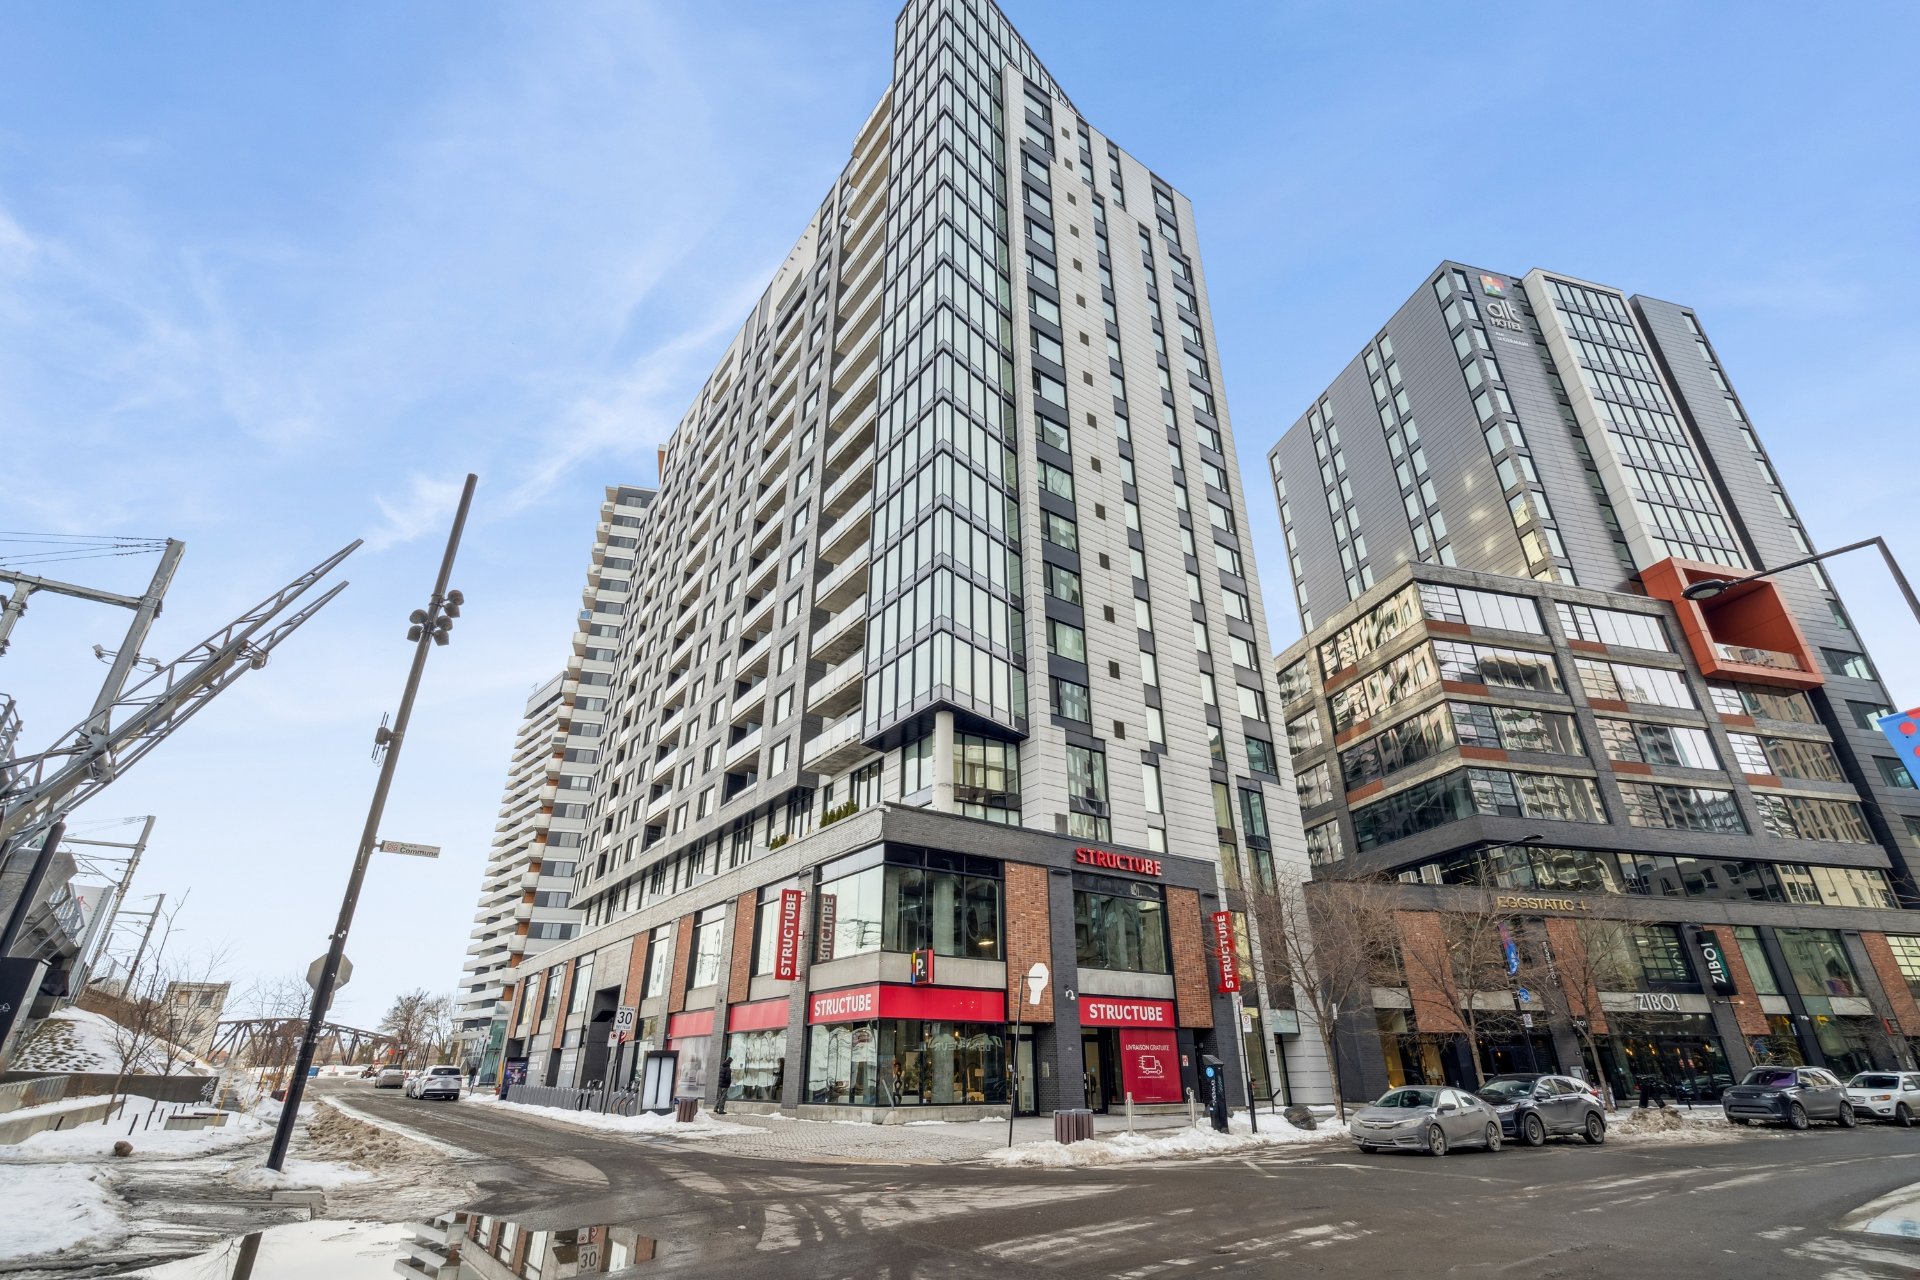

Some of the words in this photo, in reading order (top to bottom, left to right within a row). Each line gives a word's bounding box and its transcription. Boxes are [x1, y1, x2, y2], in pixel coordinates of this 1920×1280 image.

[1487, 300, 1520, 322] alt
[1075, 847, 1162, 876] STRUCTUBE
[1497, 896, 1575, 911] EGGSTATIC
[781, 893, 797, 976] STRUCTUBE
[1217, 914, 1234, 989] STRUCTUBE
[916, 958, 923, 976] P
[1700, 942, 1726, 984] ZIBO!
[814, 993, 872, 1017] STRUCTUBE
[1089, 1003, 1163, 1022] STRUCTUBE
[1636, 993, 1681, 1011] ZIBO!
[617, 1011, 633, 1025] 30
